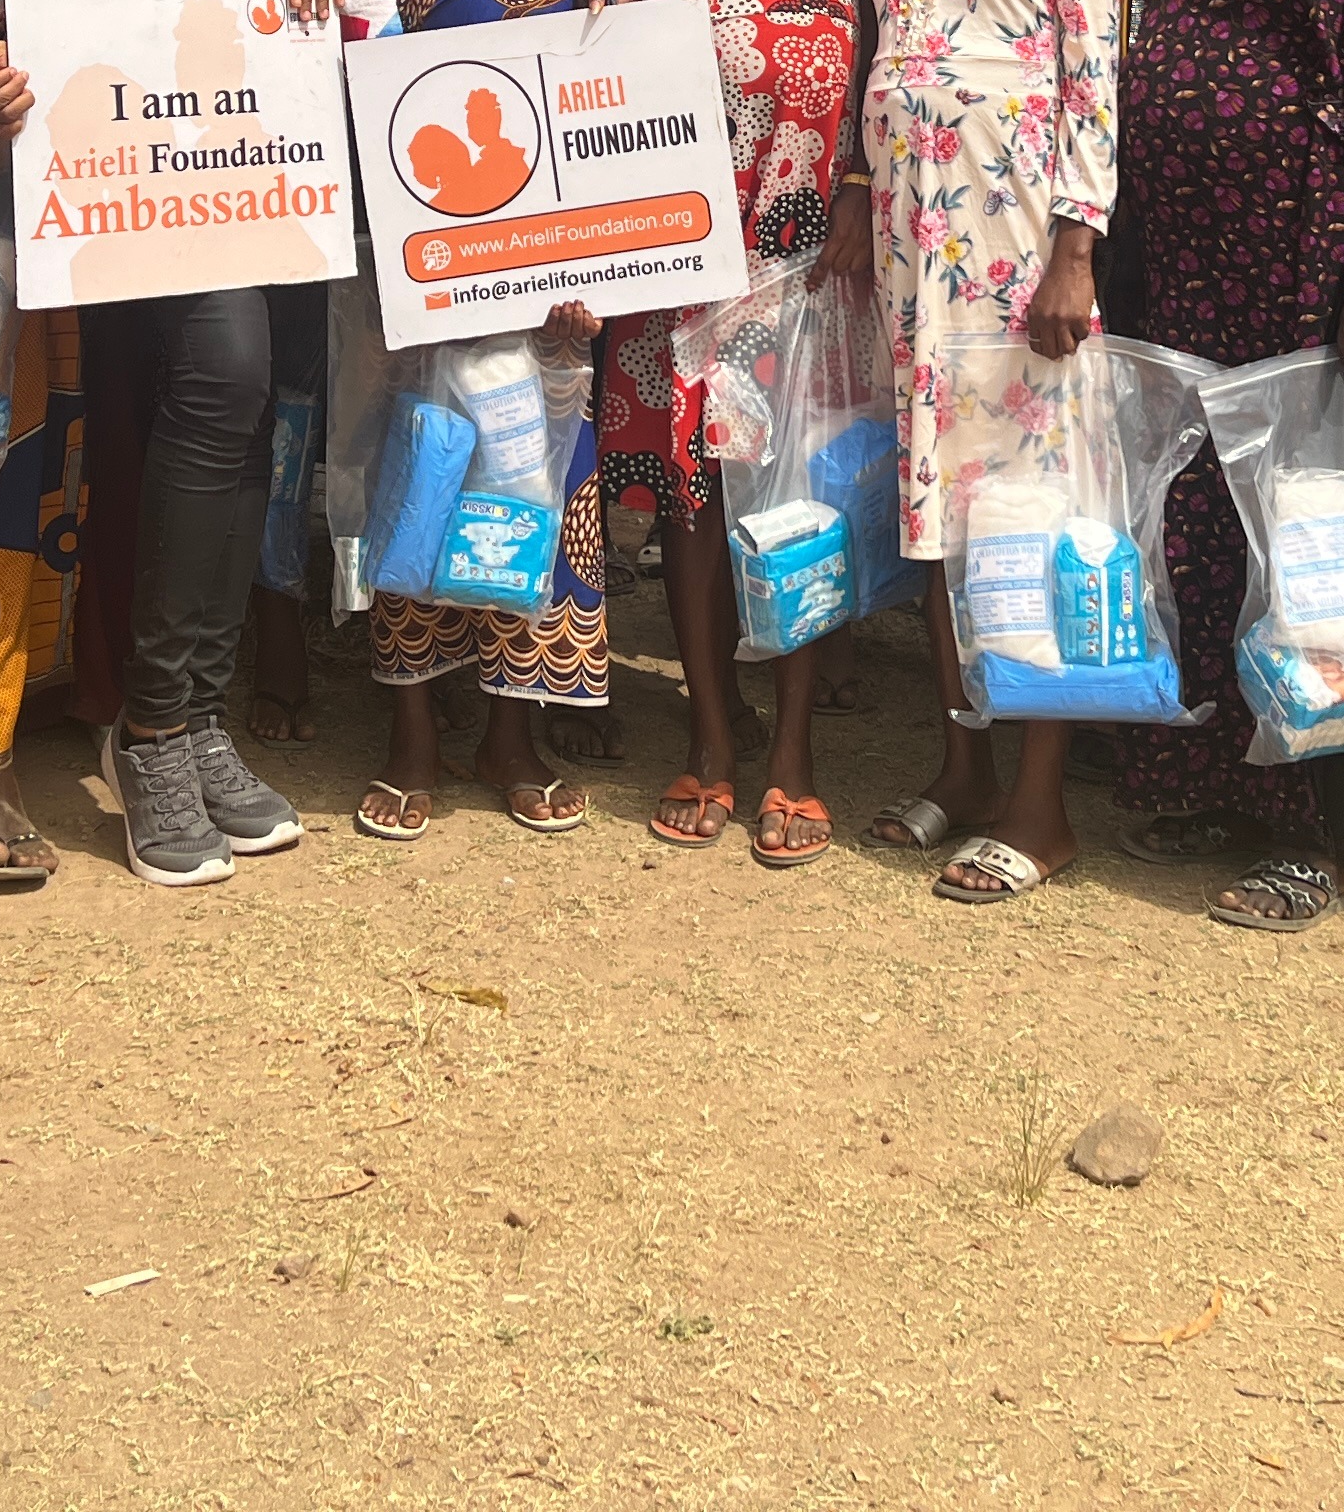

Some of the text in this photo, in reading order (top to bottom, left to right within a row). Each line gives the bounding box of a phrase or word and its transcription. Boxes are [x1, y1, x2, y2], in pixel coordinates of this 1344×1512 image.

[109, 83, 260, 121] I am an
[558, 75, 626, 114] ARIELI
[43, 135, 325, 181] Arieli Foundation
[563, 113, 698, 162] FOUNDATION
[30, 172, 339, 240] Ambassador
[458, 208, 693, 258] www.ArieliFoundation.org
[453, 254, 703, 304] info@arielifoundation.org
